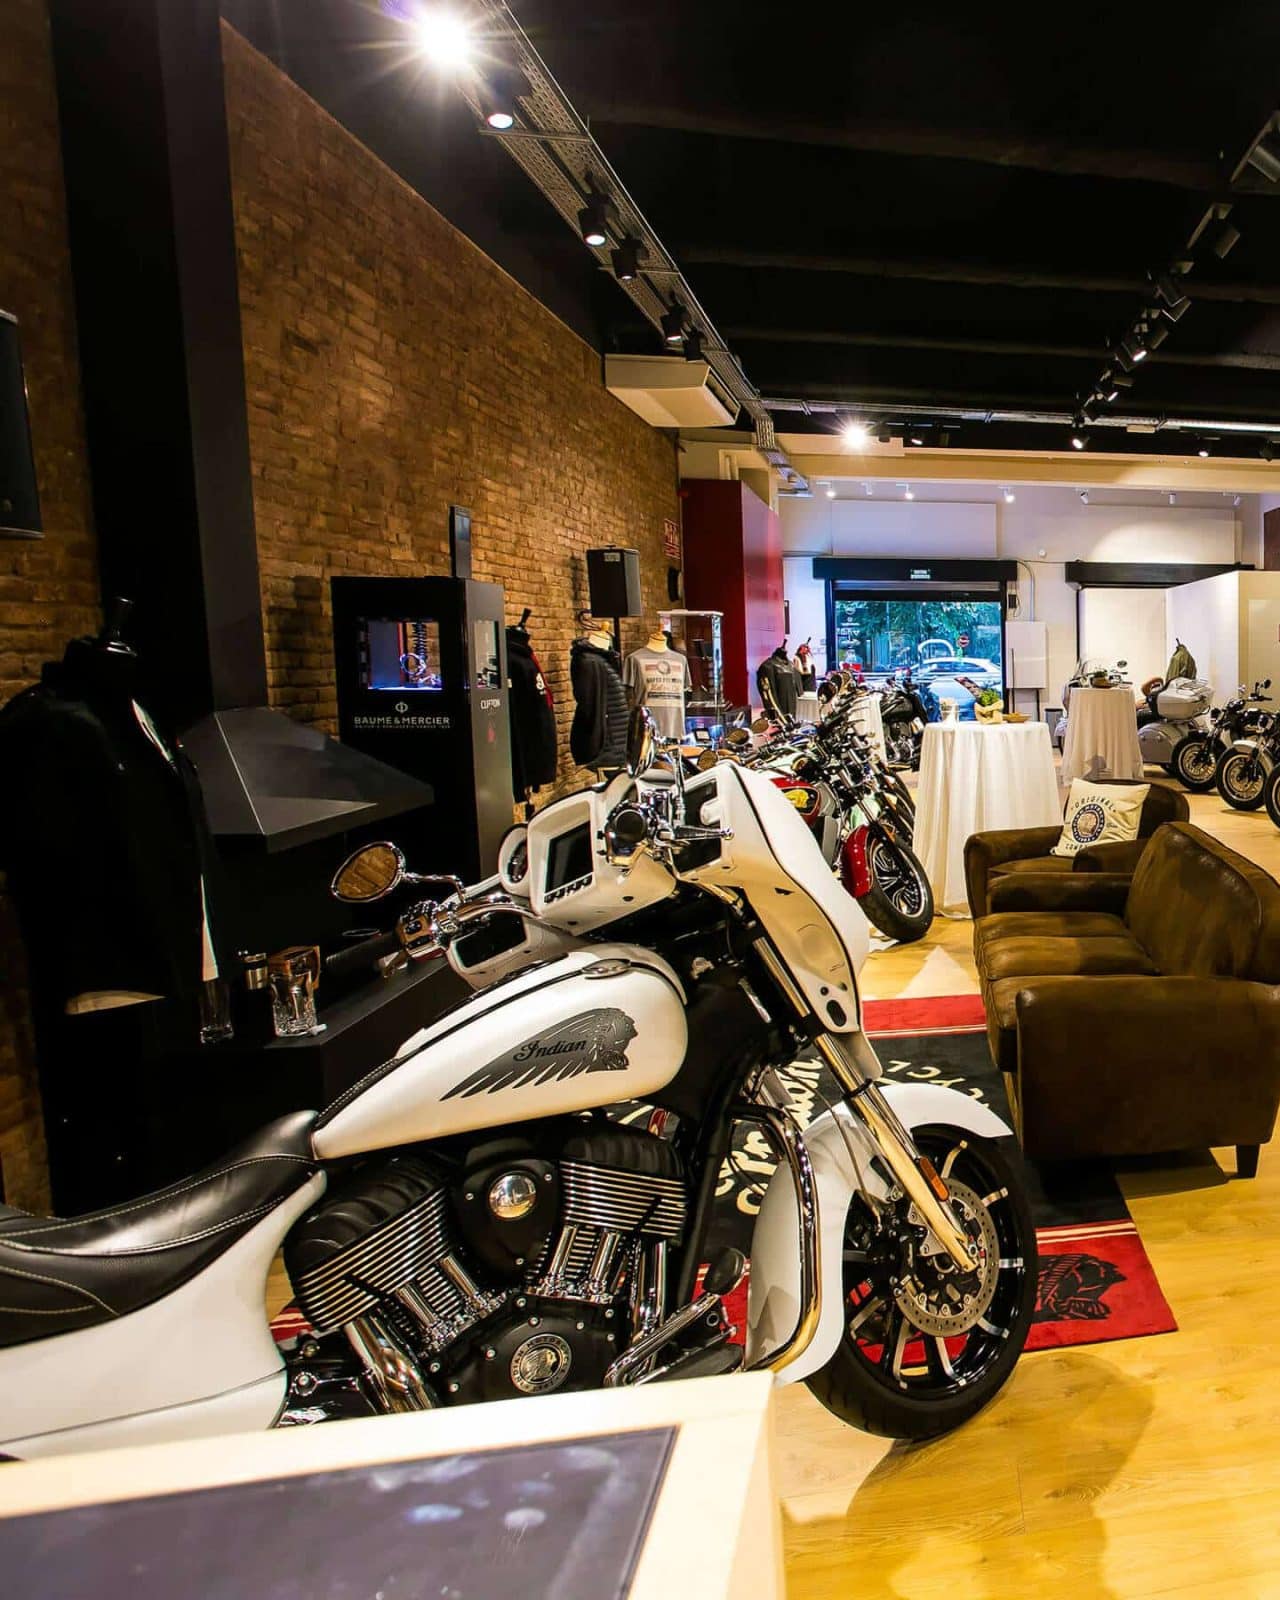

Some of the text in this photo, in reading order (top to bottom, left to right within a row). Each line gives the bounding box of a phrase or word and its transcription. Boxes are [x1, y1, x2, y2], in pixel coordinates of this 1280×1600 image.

[354, 716, 392, 725] BAUME
[402, 716, 450, 725] MERCIER
[513, 1040, 587, 1062] Indian
